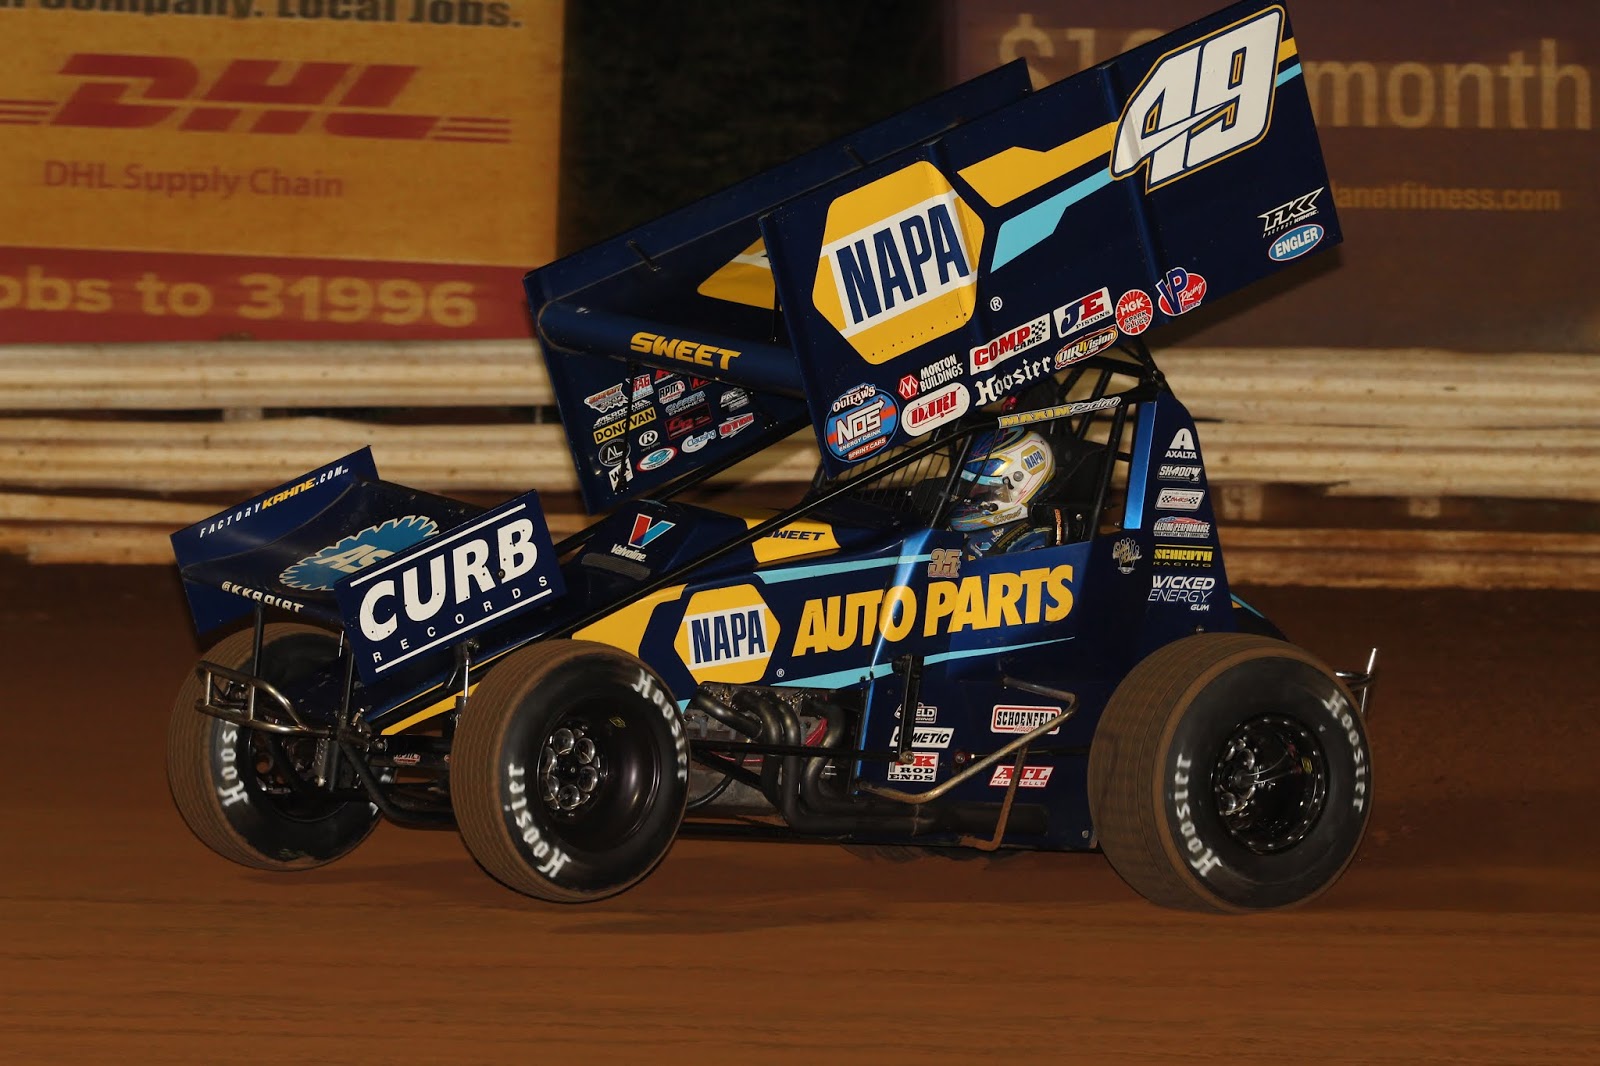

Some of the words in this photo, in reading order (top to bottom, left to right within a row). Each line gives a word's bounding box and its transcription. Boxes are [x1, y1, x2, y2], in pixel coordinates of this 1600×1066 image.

[408, 0, 521, 28] Jobs.
[48, 53, 438, 140] DHL
[1110, 7, 1284, 188] 49
[44, 160, 115, 188] DHL
[124, 163, 241, 199] Supply
[249, 169, 345, 197] Chain
[1275, 226, 1319, 258] ENGLER
[836, 203, 970, 325] NAPA
[136, 272, 211, 317] to
[238, 272, 477, 328] 31996
[1156, 267, 1189, 316] VP
[1181, 281, 1203, 303] Racing
[1061, 290, 1104, 332] JE
[1075, 310, 1110, 330] PISTONS
[1123, 311, 1148, 324] SPARK
[1125, 318, 1150, 332] PLUGS
[630, 331, 741, 371] SWEET
[974, 325, 1031, 367] COMP
[1013, 333, 1043, 353] CAMS
[919, 363, 964, 392] BUILDINGS
[920, 353, 957, 381] MORTON
[974, 355, 1052, 407] Hoosier
[832, 385, 876, 413] OUTLAWS
[836, 408, 882, 446] NOS
[1001, 406, 1072, 427] MAXIM
[839, 436, 863, 453] ENERGY
[862, 429, 882, 442] DRINK
[848, 446, 870, 460] SPRINT
[869, 437, 886, 450] CARS
[1164, 450, 1198, 460] AXALTA
[1024, 452, 1044, 469] NAPA
[1159, 465, 1202, 479] SHADOW
[610, 543, 647, 562] Valvoline
[928, 549, 962, 578] 35
[1153, 549, 1213, 562] SCHROTH
[359, 517, 538, 642] CURB
[1152, 575, 1216, 590] WICKED
[1147, 588, 1213, 602] ENERGY
[1190, 603, 1210, 612] GUM
[690, 609, 766, 664] NAPA
[792, 585, 917, 657] AUTO
[924, 564, 1074, 637] PARTS
[632, 668, 689, 783] Hoosier
[996, 711, 1056, 727] SCHOENFELD
[1321, 689, 1369, 813] Hoosier
[888, 774, 934, 782] ENDS
[508, 763, 572, 878] Hoosier
[1166, 753, 1223, 878] Hoosier
